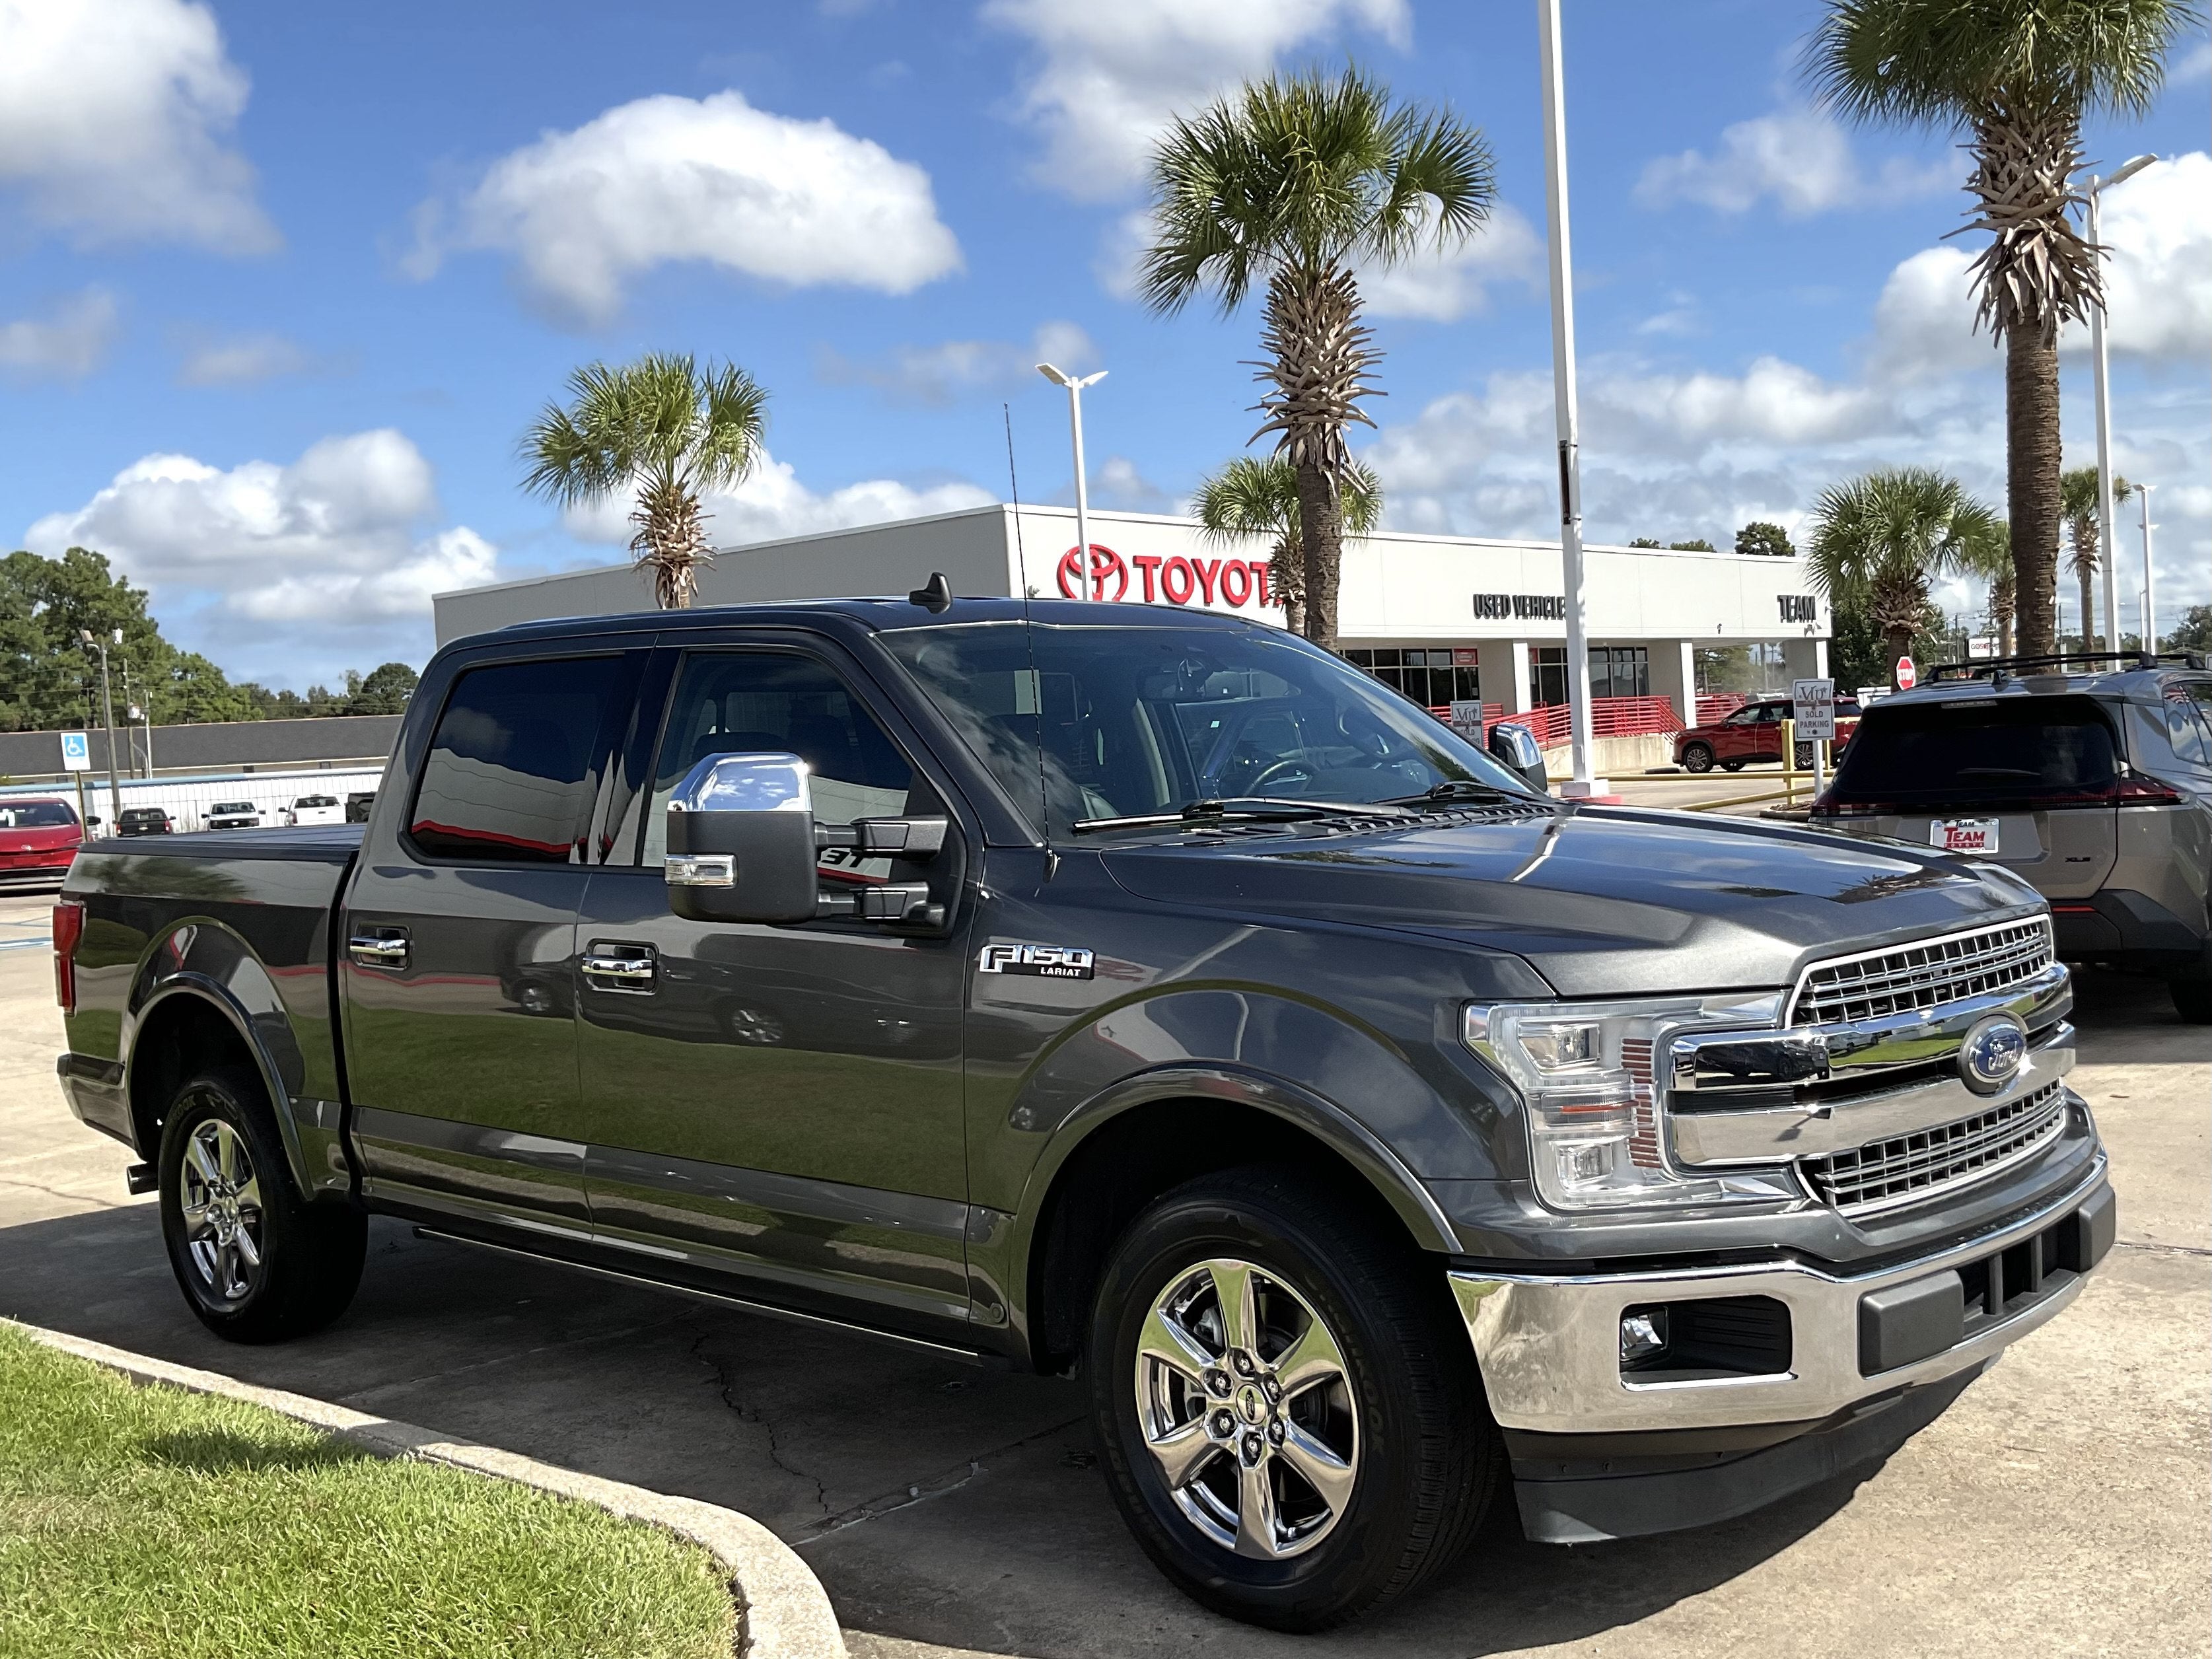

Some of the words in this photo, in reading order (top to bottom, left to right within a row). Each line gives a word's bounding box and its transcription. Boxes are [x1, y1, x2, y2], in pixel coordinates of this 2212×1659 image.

[1132, 555, 1284, 607] TOYOT
[1473, 594, 1511, 619] USED
[1777, 595, 1816, 622] TEAM
[1898, 668, 1914, 681] STOP
[1944, 826, 1985, 842] TEAM
[1040, 966, 1081, 977] LARIAT
[1988, 1039, 2018, 1071] Ford
